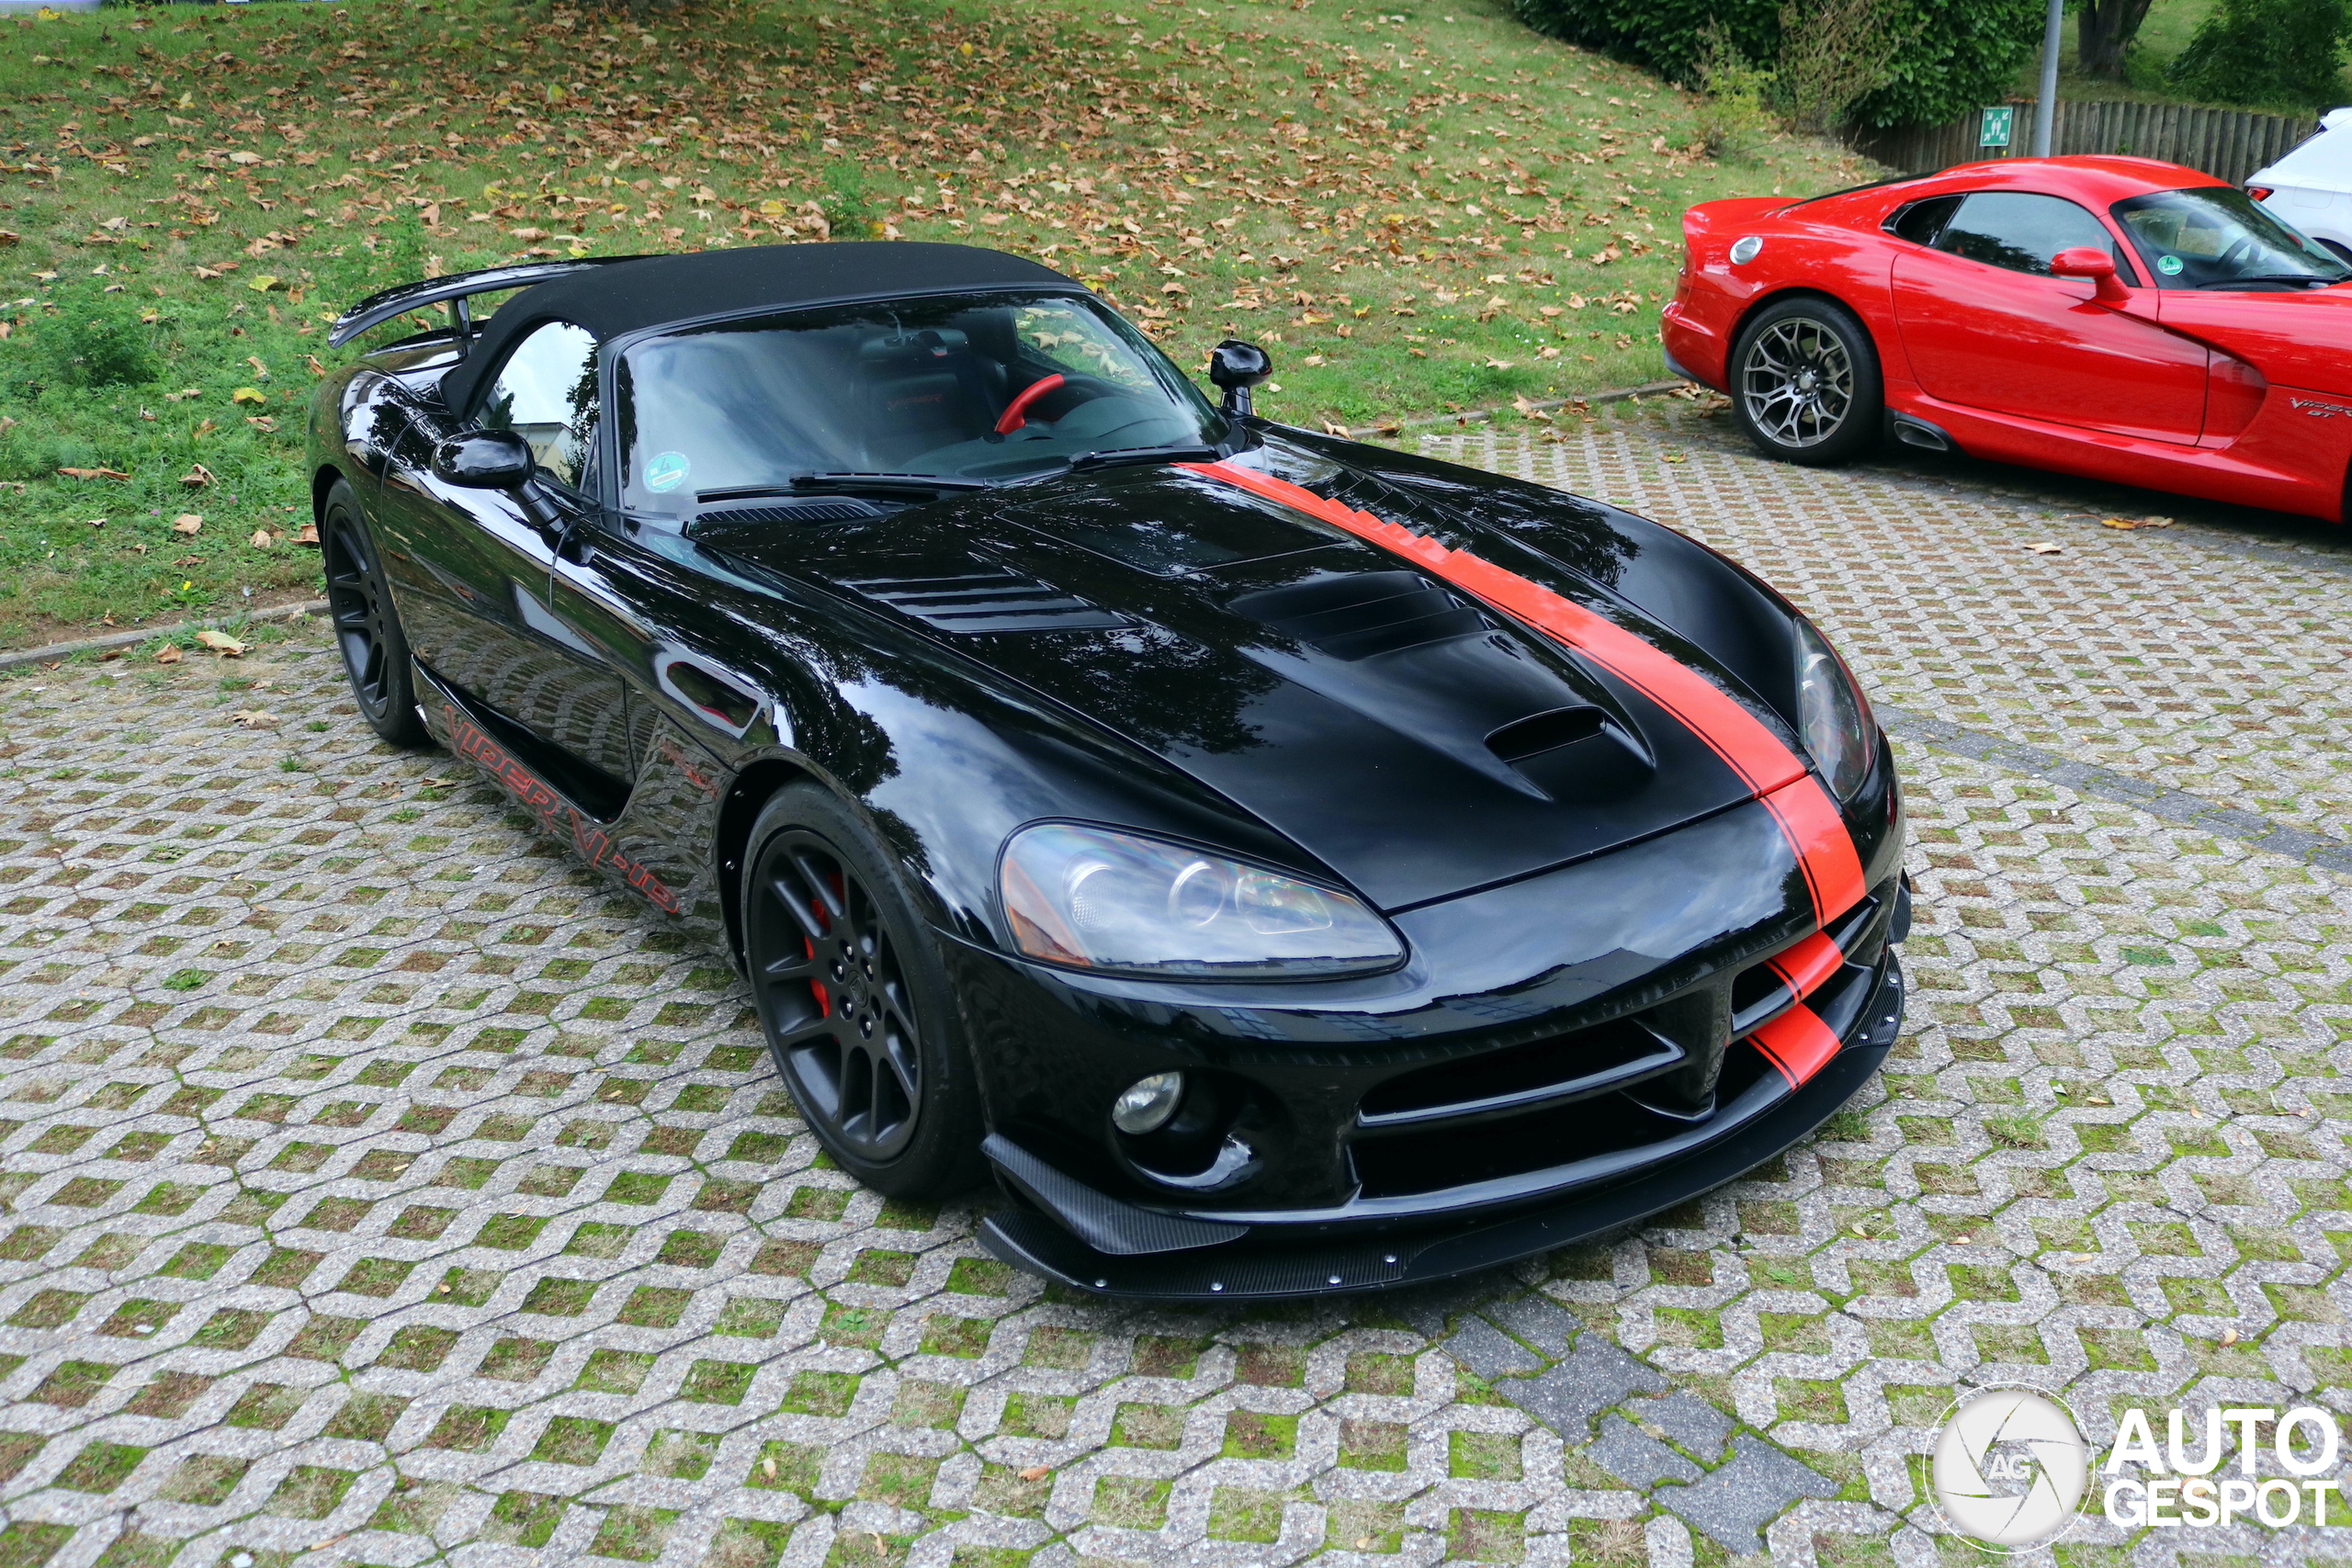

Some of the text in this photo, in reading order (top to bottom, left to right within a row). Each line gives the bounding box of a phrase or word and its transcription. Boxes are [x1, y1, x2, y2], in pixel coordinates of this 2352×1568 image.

[2307, 410, 2335, 418] GT
[660, 457, 671, 472] 4
[445, 705, 559, 834] VIPER
[569, 808, 679, 914] V-10
